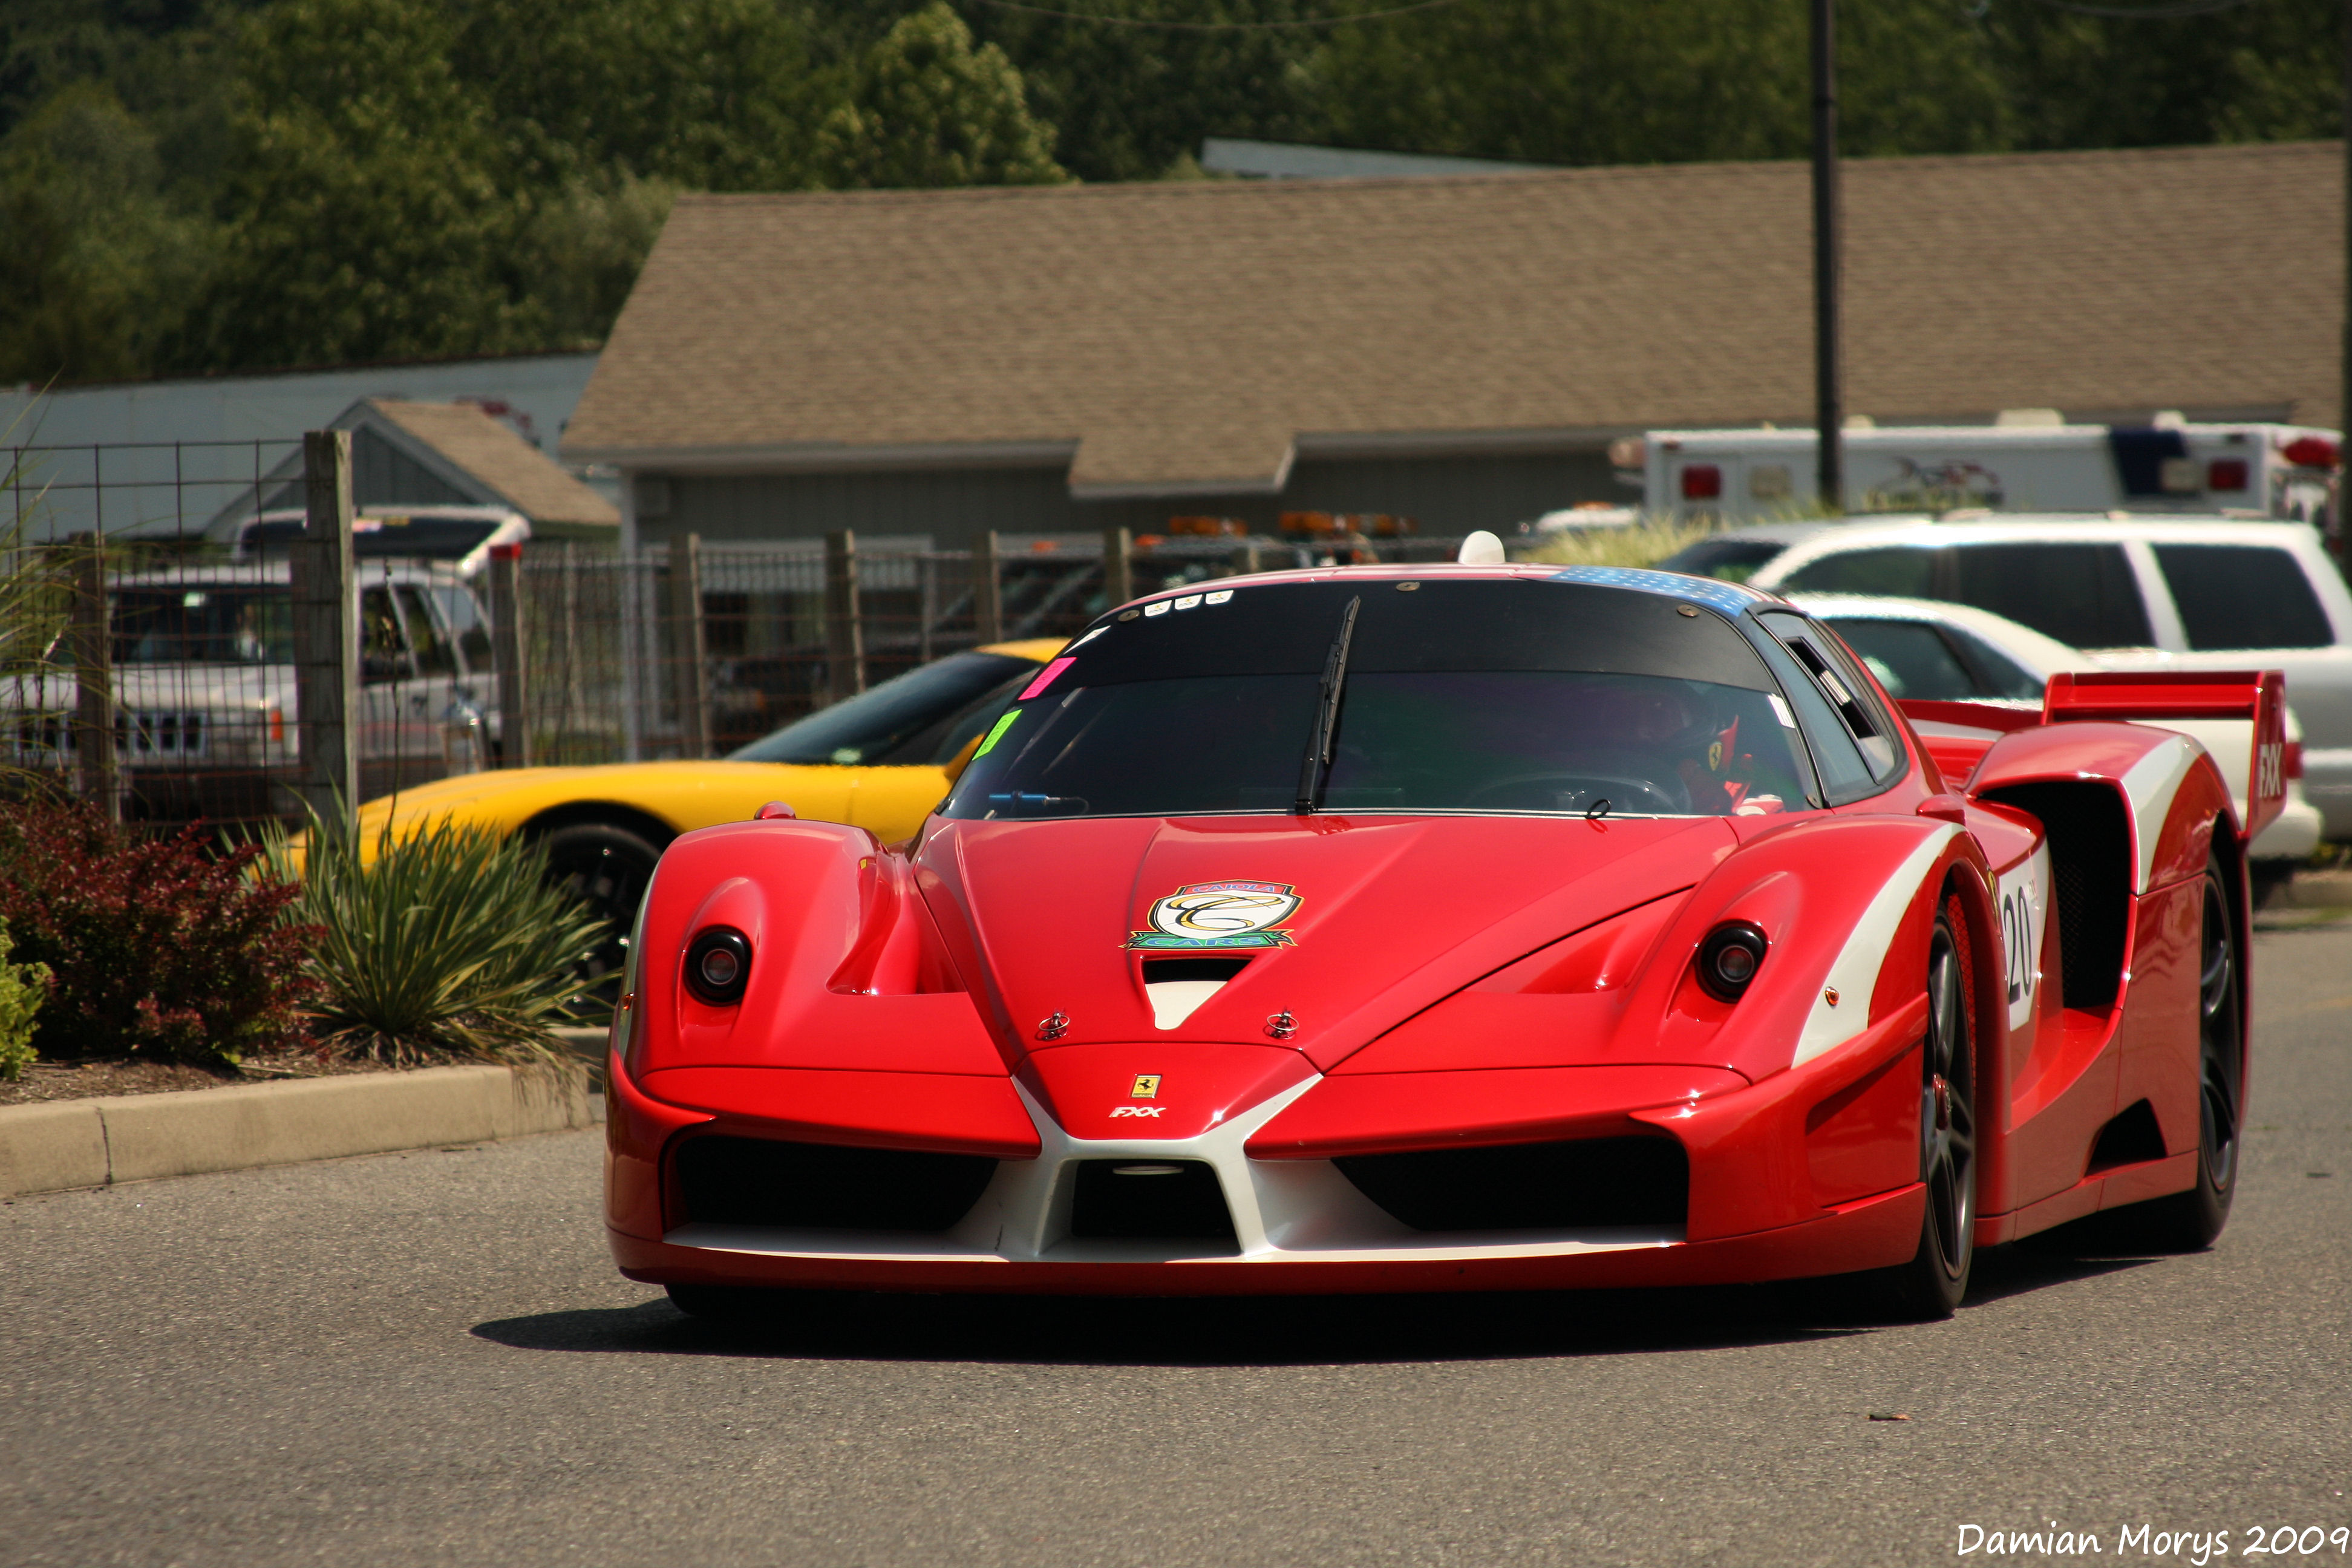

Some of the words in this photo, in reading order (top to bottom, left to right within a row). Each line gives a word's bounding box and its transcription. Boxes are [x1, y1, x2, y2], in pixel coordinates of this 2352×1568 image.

[2258, 743, 2282, 798] FXX
[1192, 883, 1275, 893] CAIOLA
[1146, 937, 1264, 947] CARS
[2004, 886, 2033, 1005] 20
[1108, 1106, 1167, 1118] FXX
